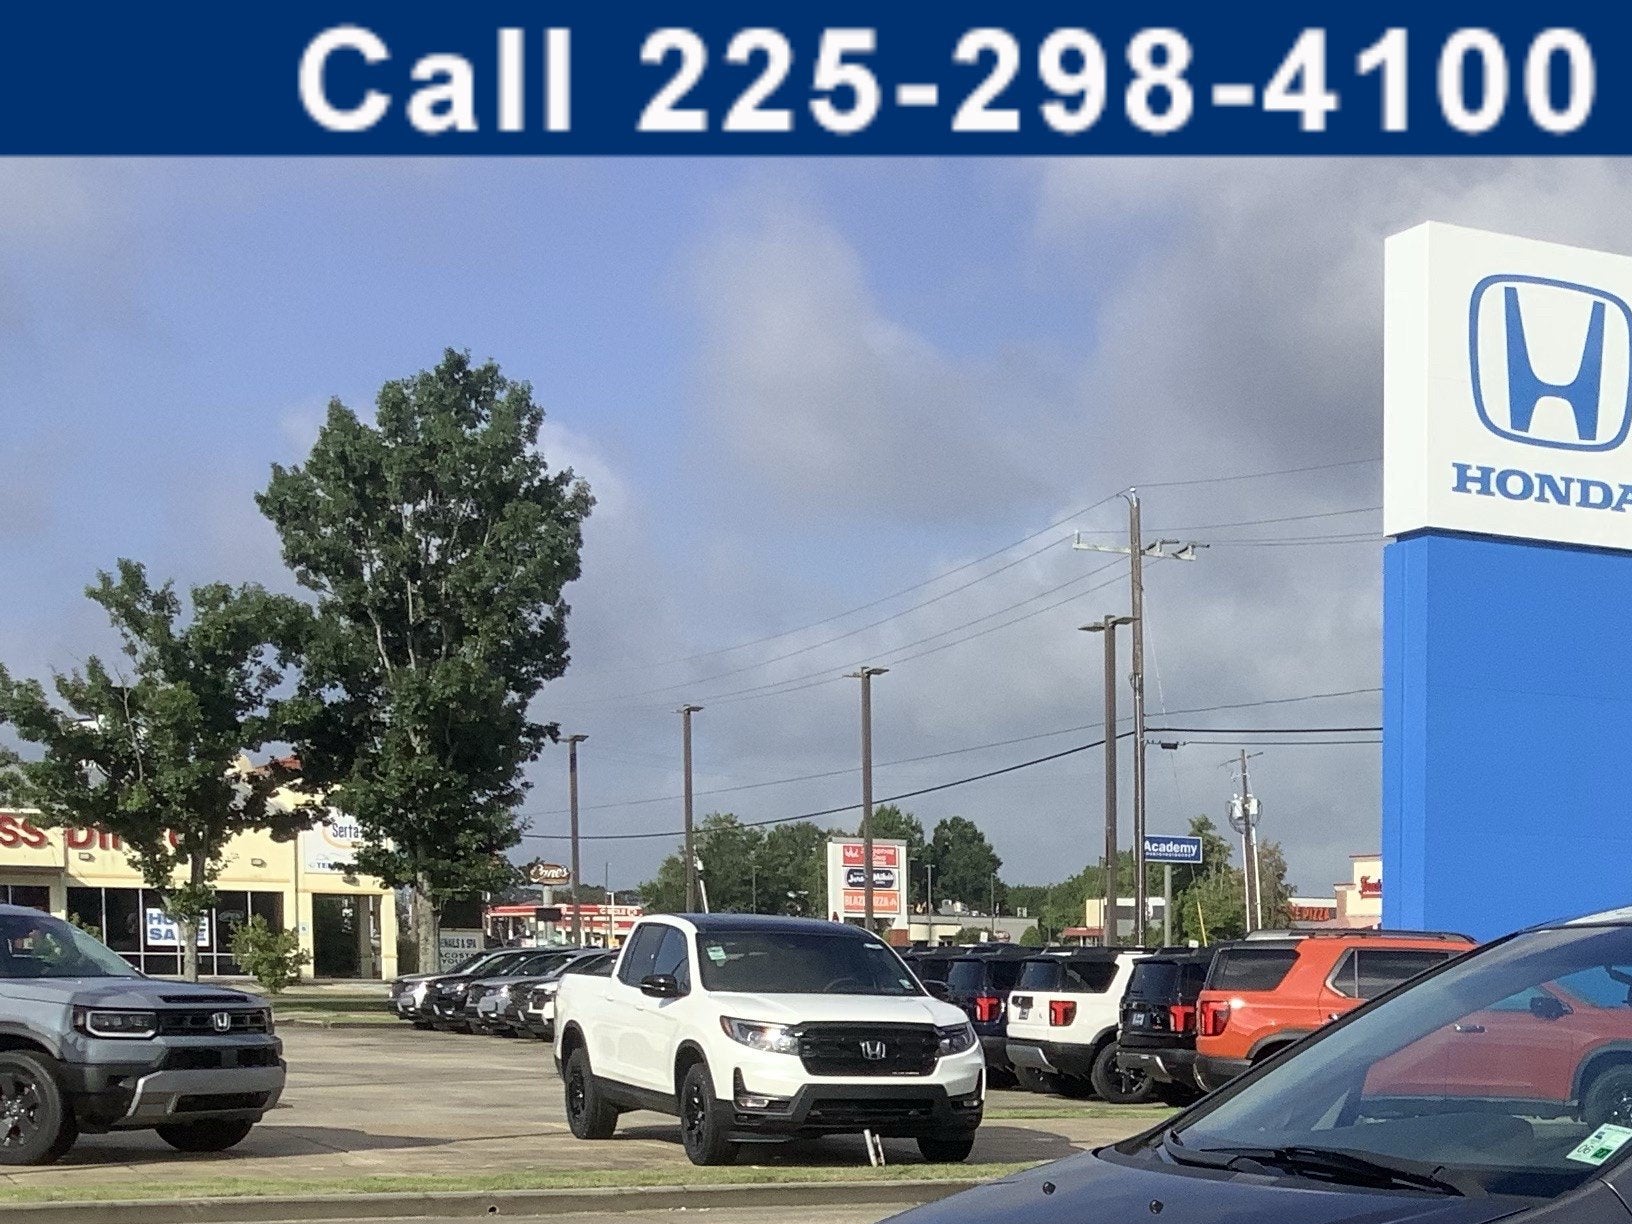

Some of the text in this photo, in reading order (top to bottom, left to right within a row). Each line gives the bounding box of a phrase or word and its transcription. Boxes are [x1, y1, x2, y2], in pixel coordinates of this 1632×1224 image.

[332, 822, 359, 838] Serta
[1144, 840, 1198, 856] Academy
[844, 896, 865, 906] BLAZ
[149, 928, 207, 941] SAE
